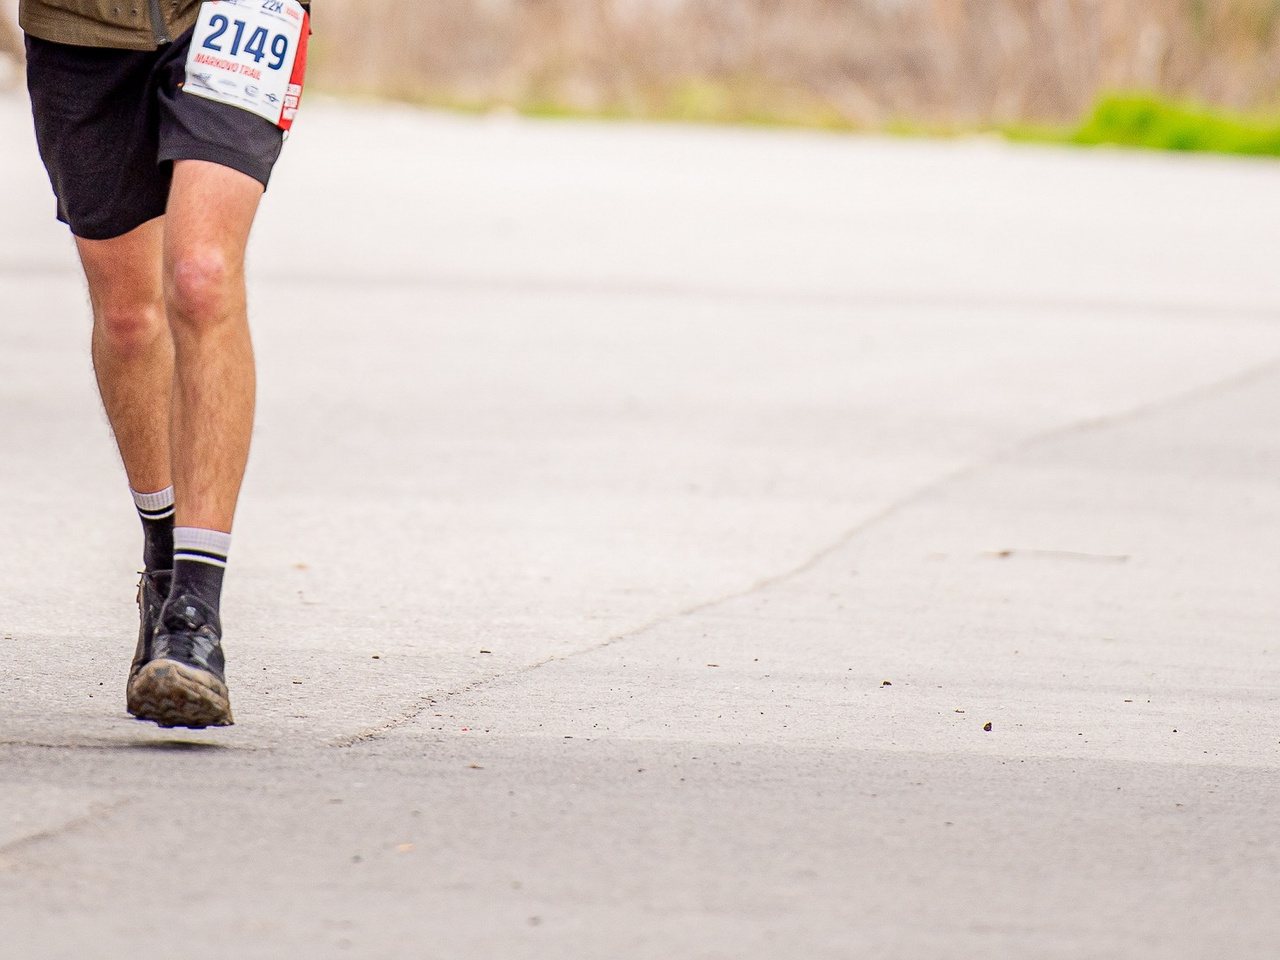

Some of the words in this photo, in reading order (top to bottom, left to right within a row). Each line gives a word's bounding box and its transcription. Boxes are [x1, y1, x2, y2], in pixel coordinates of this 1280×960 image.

[202, 13, 289, 71] 2149
[194, 52, 240, 74] MARKOVO
[239, 63, 262, 81] TRAIL
